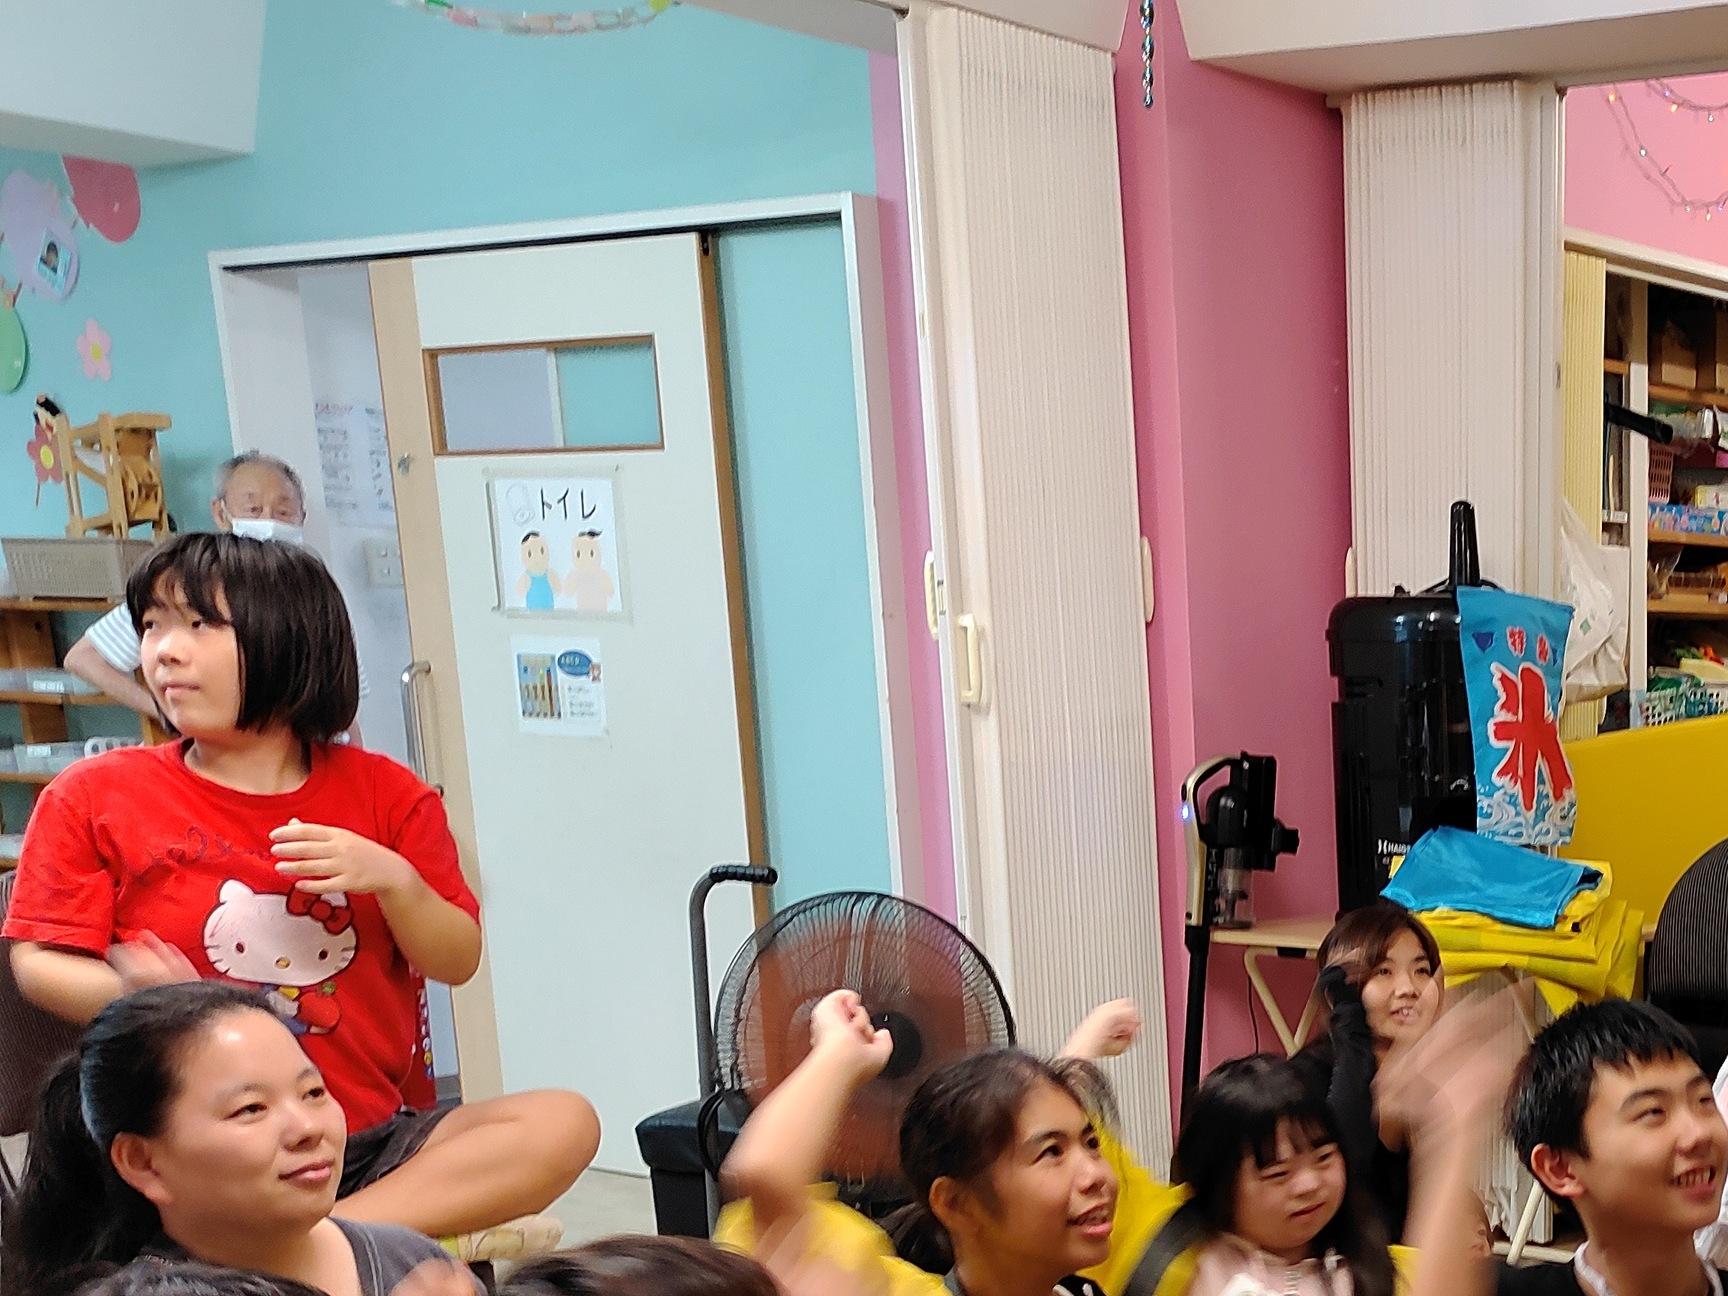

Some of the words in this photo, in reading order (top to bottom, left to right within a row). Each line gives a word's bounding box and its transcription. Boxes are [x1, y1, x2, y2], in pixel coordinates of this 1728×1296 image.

[540, 487, 597, 521] トイレ
[1489, 662, 1575, 812] 氷
